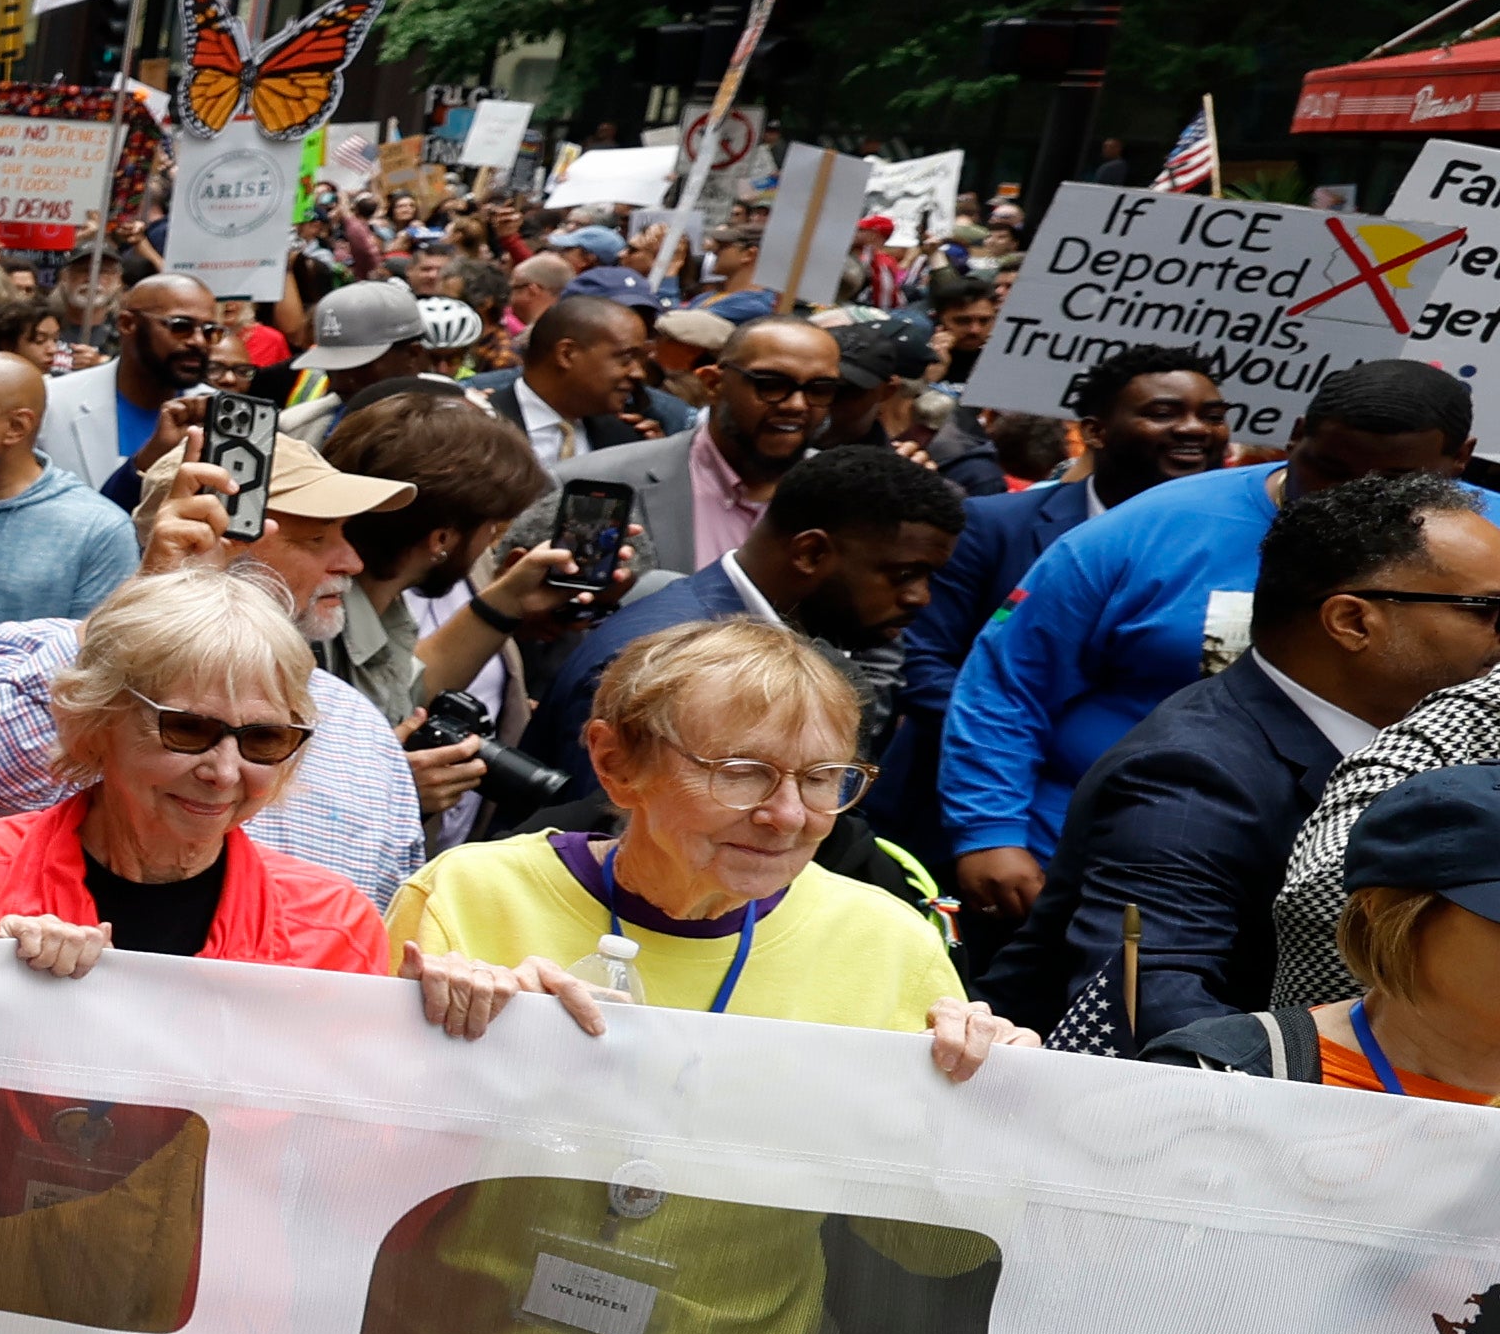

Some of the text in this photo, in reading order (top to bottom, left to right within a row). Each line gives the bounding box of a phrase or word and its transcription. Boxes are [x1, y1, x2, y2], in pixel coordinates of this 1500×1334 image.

[23, 125, 50, 142] NO
[55, 124, 109, 146] TIENES
[201, 181, 273, 199] ARISE
[1101, 193, 1283, 254] If ICE
[1046, 236, 1312, 300] Deported
[1003, 315, 1140, 366] Trum
[1061, 281, 1309, 355] Criminals,
[551, 1282, 629, 1313] VOLUNTEER
